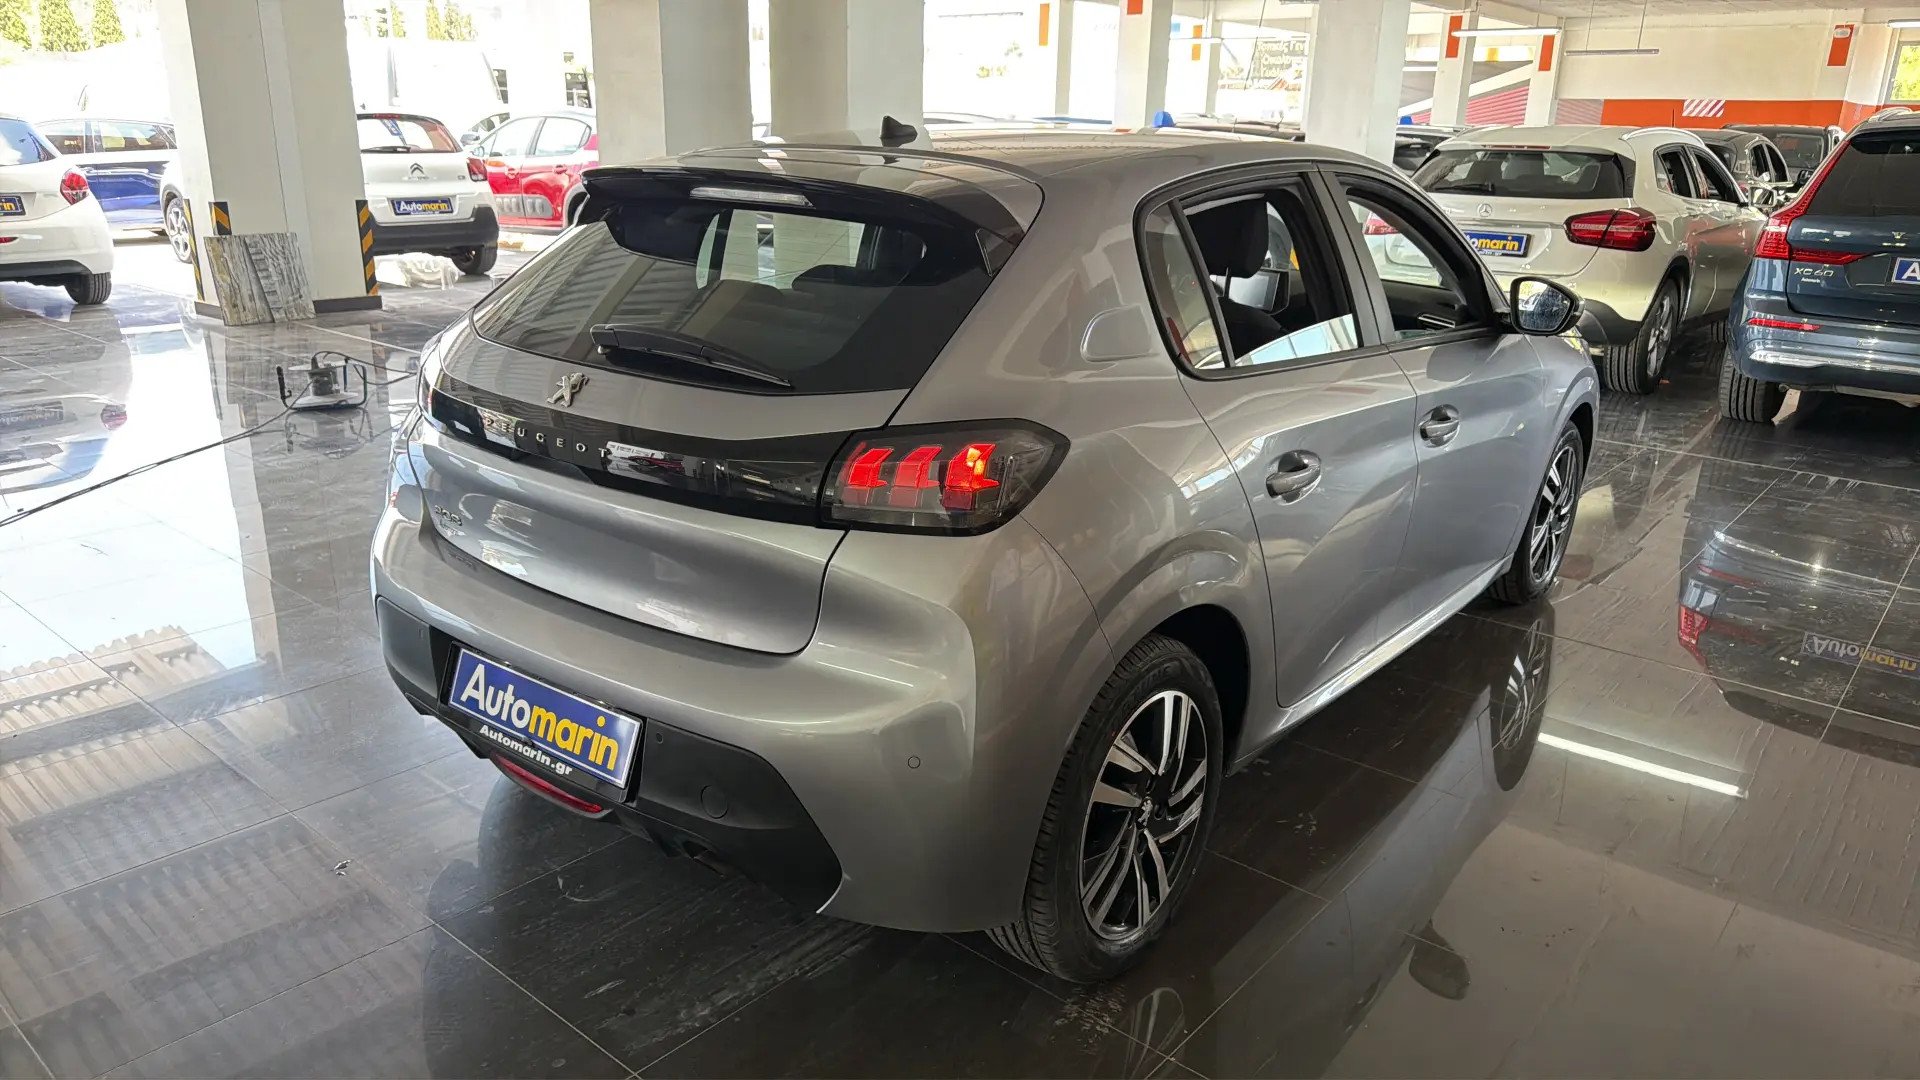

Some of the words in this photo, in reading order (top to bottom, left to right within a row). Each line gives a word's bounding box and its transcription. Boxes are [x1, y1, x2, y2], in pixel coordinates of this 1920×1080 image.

[400, 200, 448, 212] Automarin
[486, 417, 607, 458] PEUGEOT
[460, 663, 619, 771] Automarin
[479, 724, 573, 775] Automarin.gr
